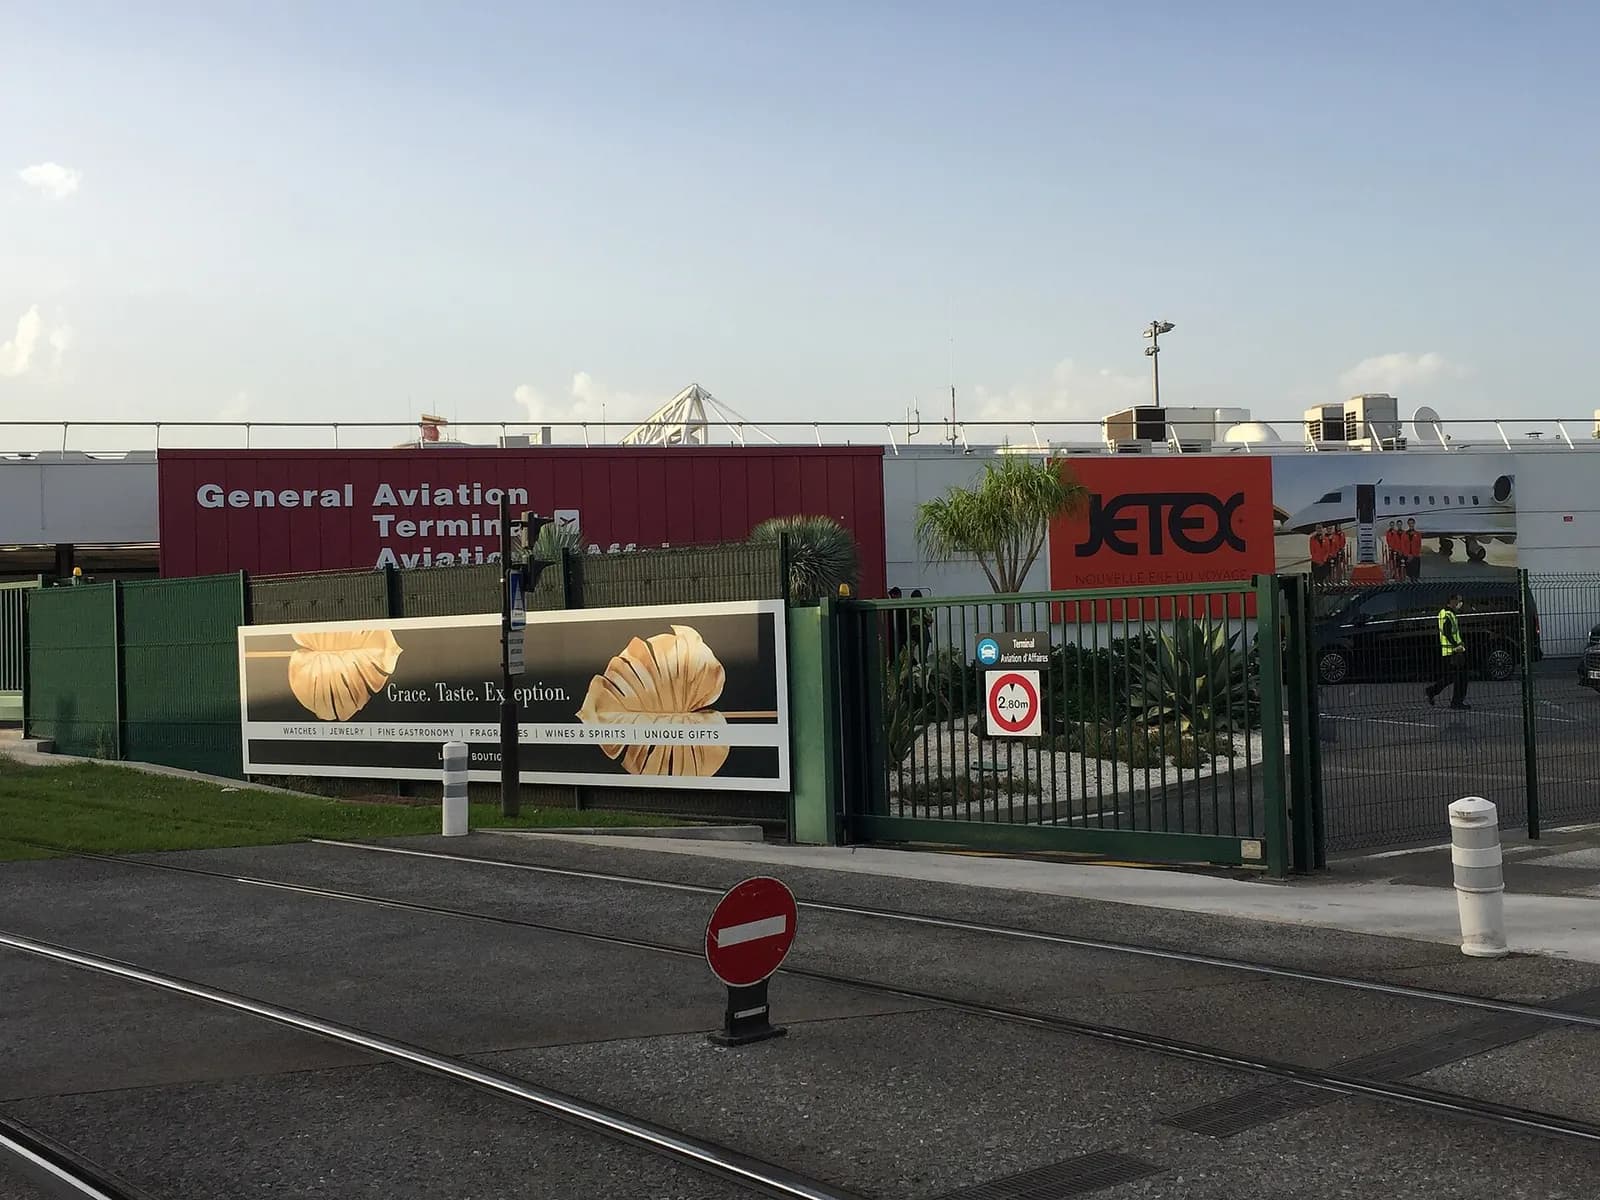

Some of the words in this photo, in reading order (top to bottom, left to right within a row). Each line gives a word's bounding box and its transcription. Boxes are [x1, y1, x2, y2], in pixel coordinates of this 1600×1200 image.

[196, 483, 353, 508] General
[372, 482, 528, 506] Aviation
[372, 513, 523, 537] Termina
[1075, 492, 1246, 557] JETEX
[1012, 637, 1035, 649] Terminal
[1000, 652, 1022, 663] Aviation
[387, 683, 431, 702] Grace.
[435, 682, 479, 702] Taste.
[484, 681, 570, 708] Exeption.
[998, 696, 1028, 709] 2,80m
[283, 727, 317, 735] WATCHES
[329, 727, 364, 736] JEWELRY
[377, 728, 396, 736] FINE
[398, 728, 455, 737] GASTRONOMY
[470, 728, 528, 738] FRAGRES
[545, 729, 576, 738] WINES
[579, 729, 585, 738] &
[589, 729, 626, 739] SPIRITS
[644, 730, 684, 740] UNIQUE
[688, 730, 720, 740] GIFTS
